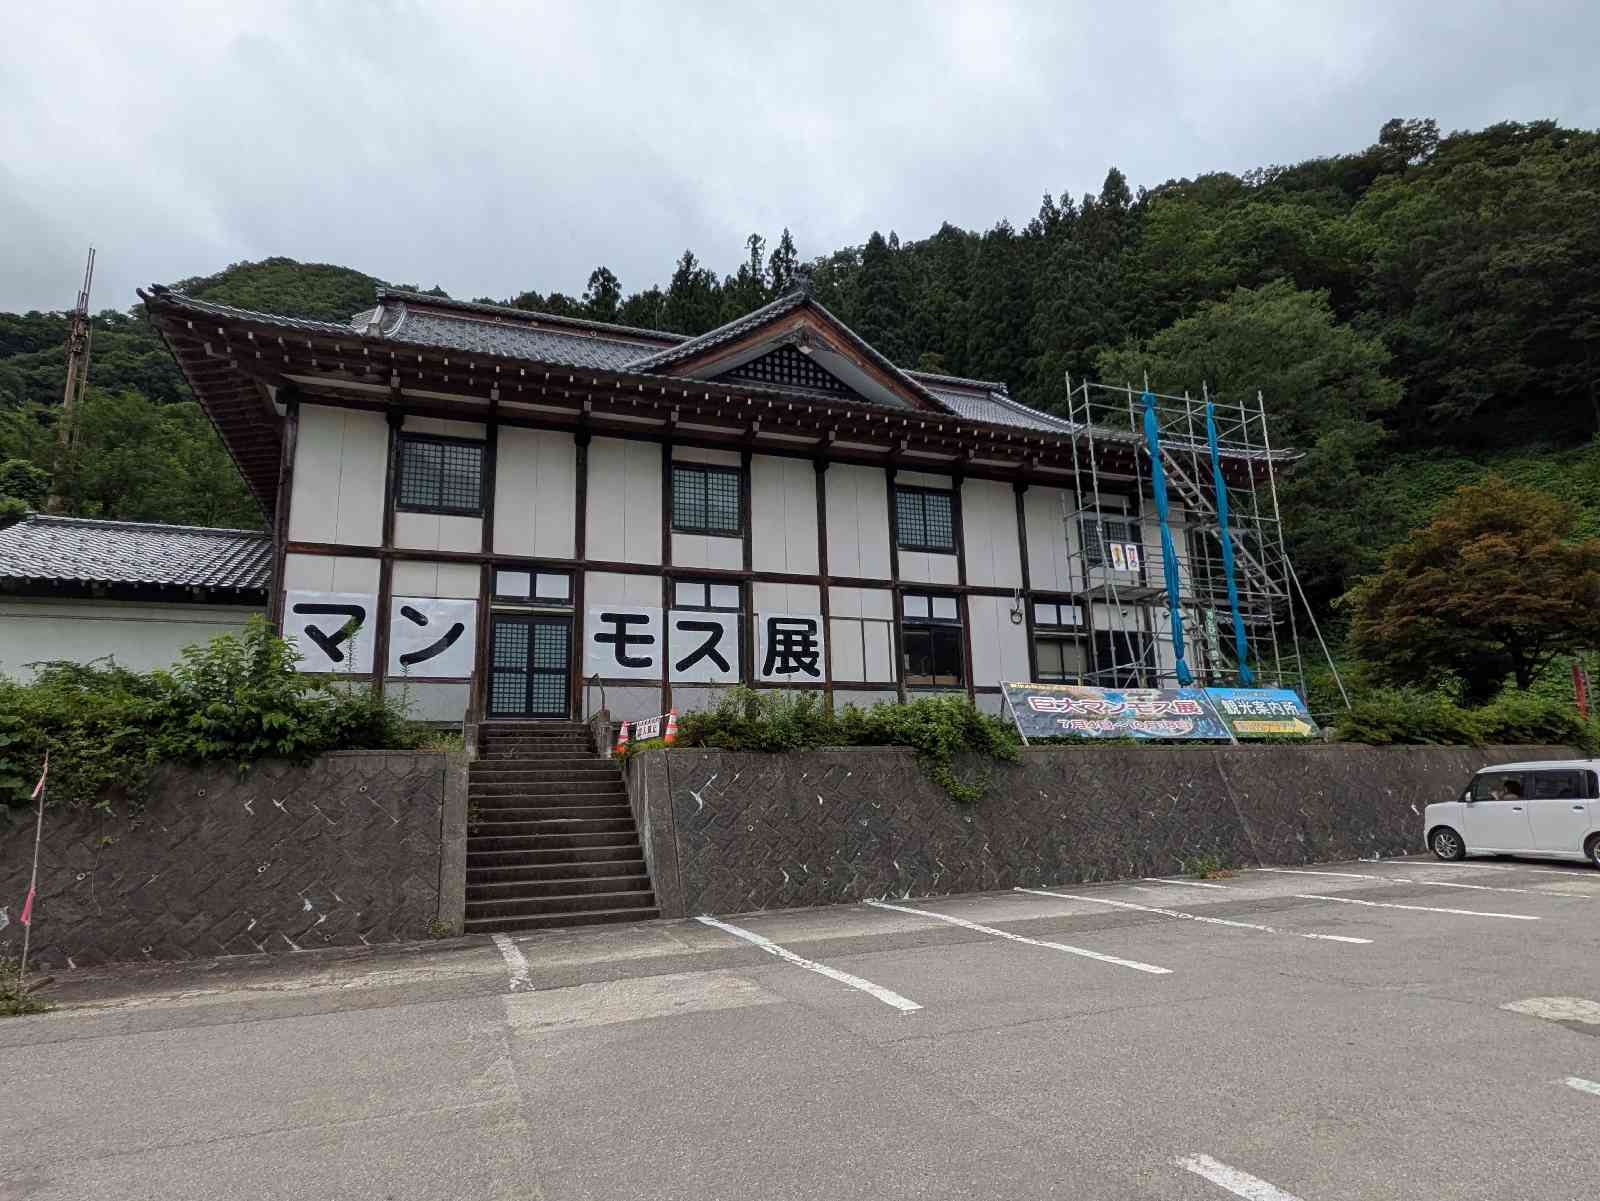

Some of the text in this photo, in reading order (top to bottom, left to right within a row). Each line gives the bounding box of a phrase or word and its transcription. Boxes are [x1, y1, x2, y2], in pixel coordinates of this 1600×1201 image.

[1027, 697, 1204, 716] 巨大マンモス展
[1221, 699, 1298, 716] 観光案内所
